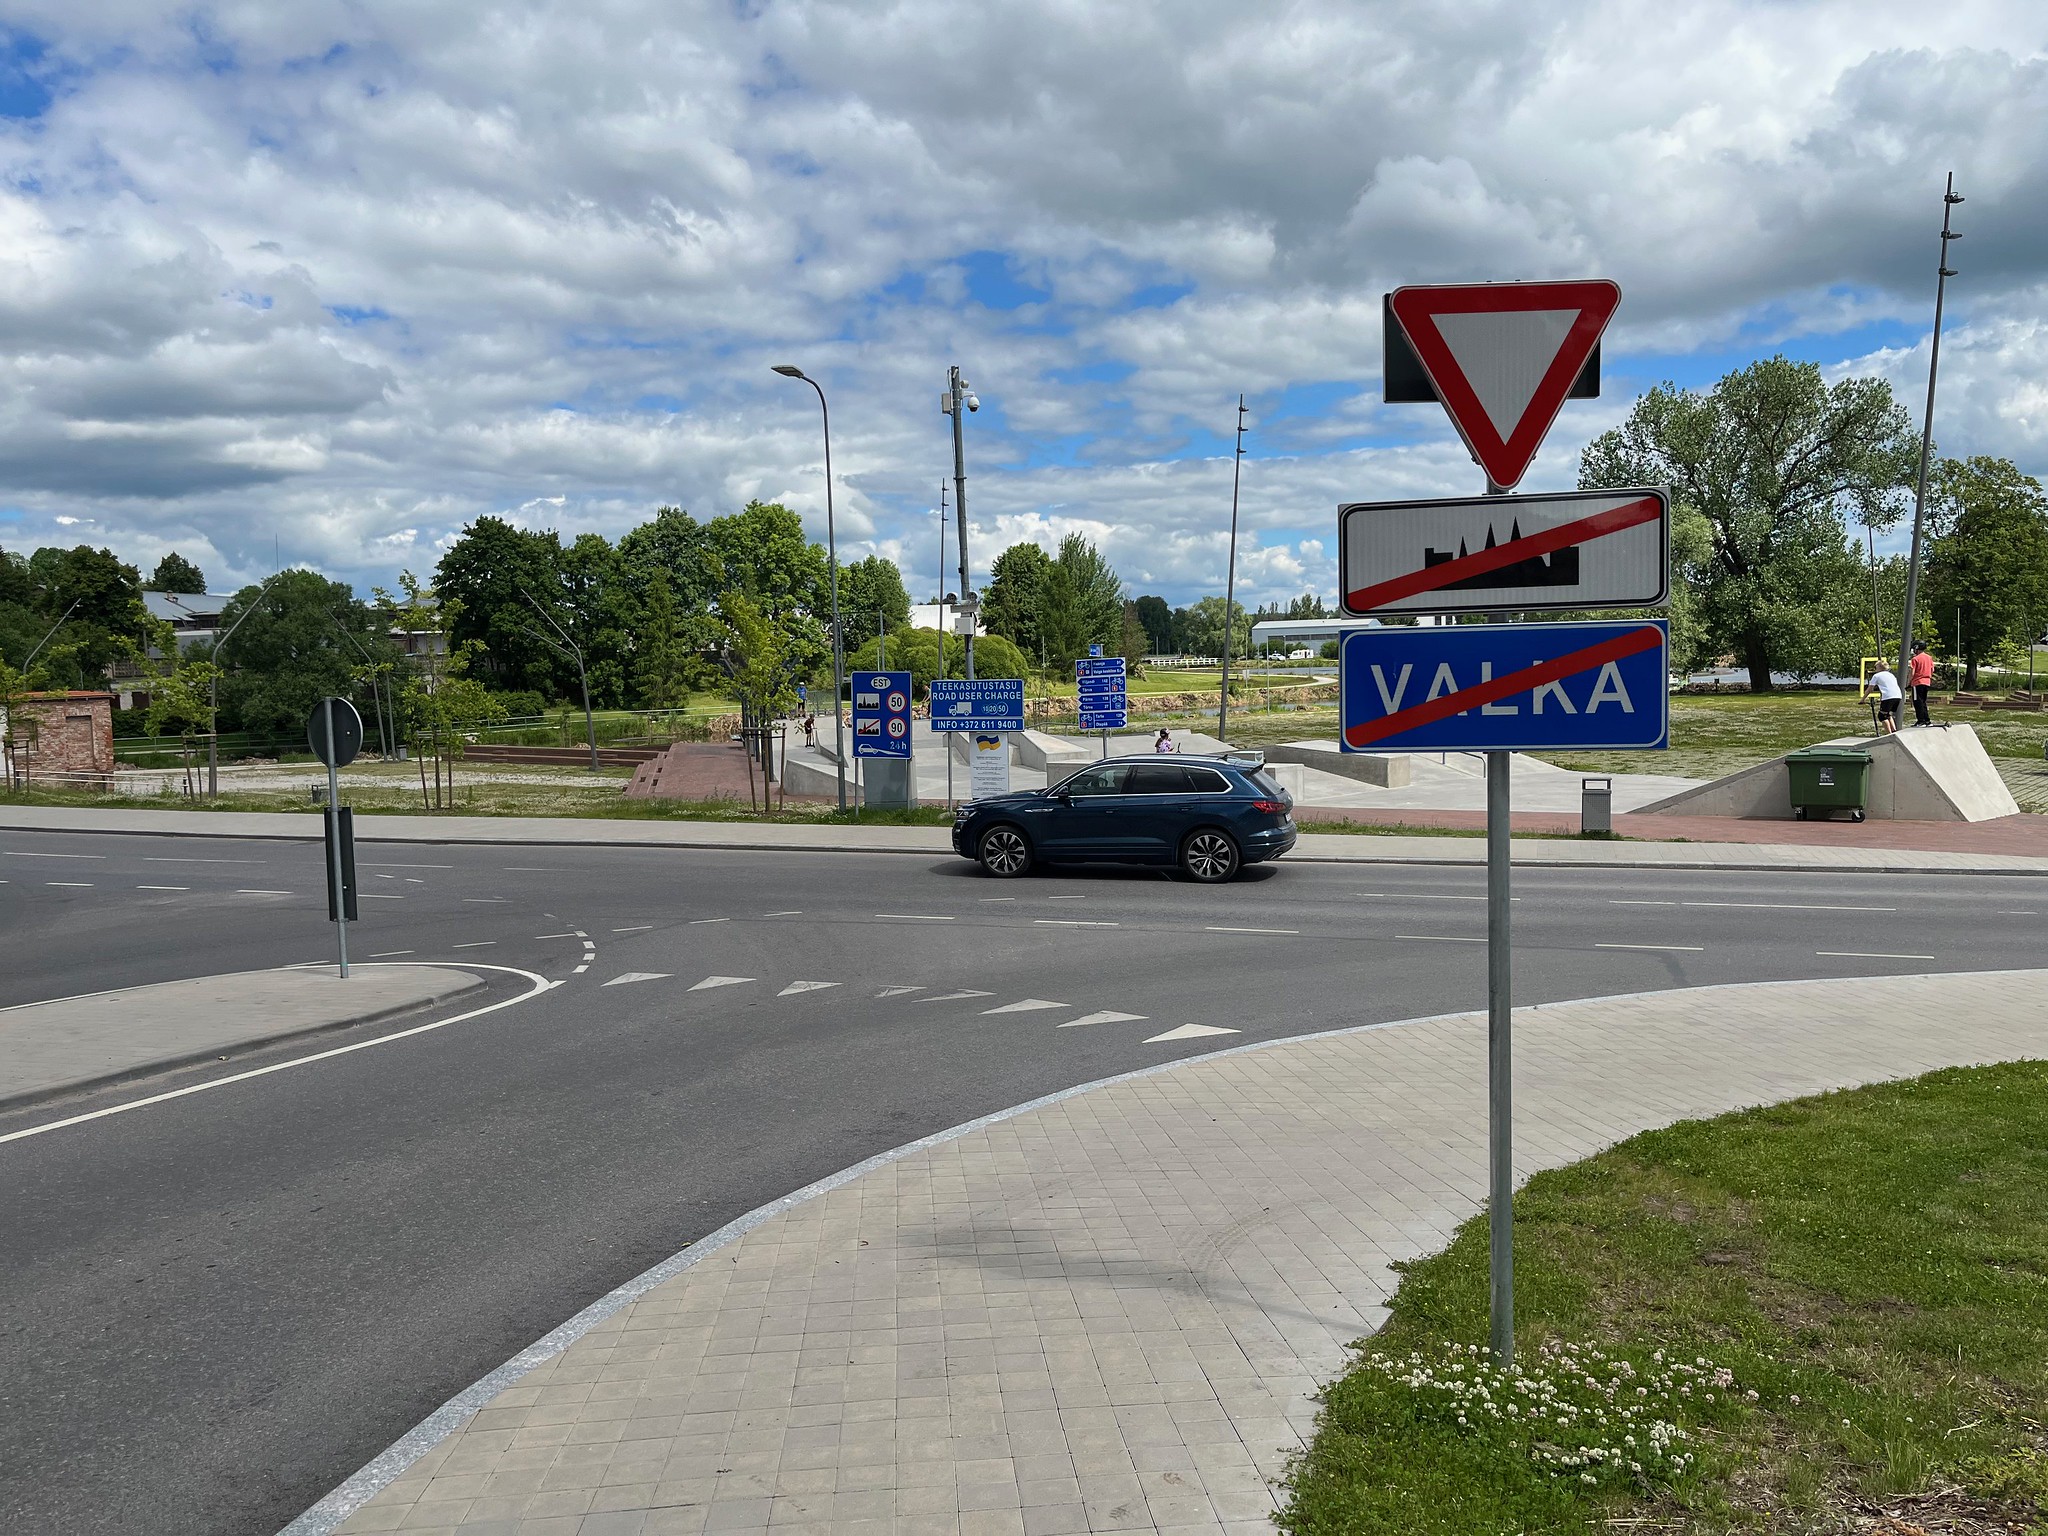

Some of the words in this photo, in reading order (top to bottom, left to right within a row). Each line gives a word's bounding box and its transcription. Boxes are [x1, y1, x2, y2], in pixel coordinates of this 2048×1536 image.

[873, 679, 888, 687] EST
[937, 682, 1017, 690] TEEKASUTUSTASU
[1370, 660, 1635, 716] VALKA
[932, 692, 957, 700] ROAD
[959, 692, 982, 700] USER
[984, 691, 1021, 699] CHARGE
[891, 697, 902, 707] 50
[891, 723, 902, 733] 90
[937, 721, 957, 729] INFO
[960, 721, 979, 729] +372
[981, 721, 994, 729] 611
[997, 720, 1017, 729] 9400
[890, 741, 900, 750] 24
[901, 741, 907, 750] h
